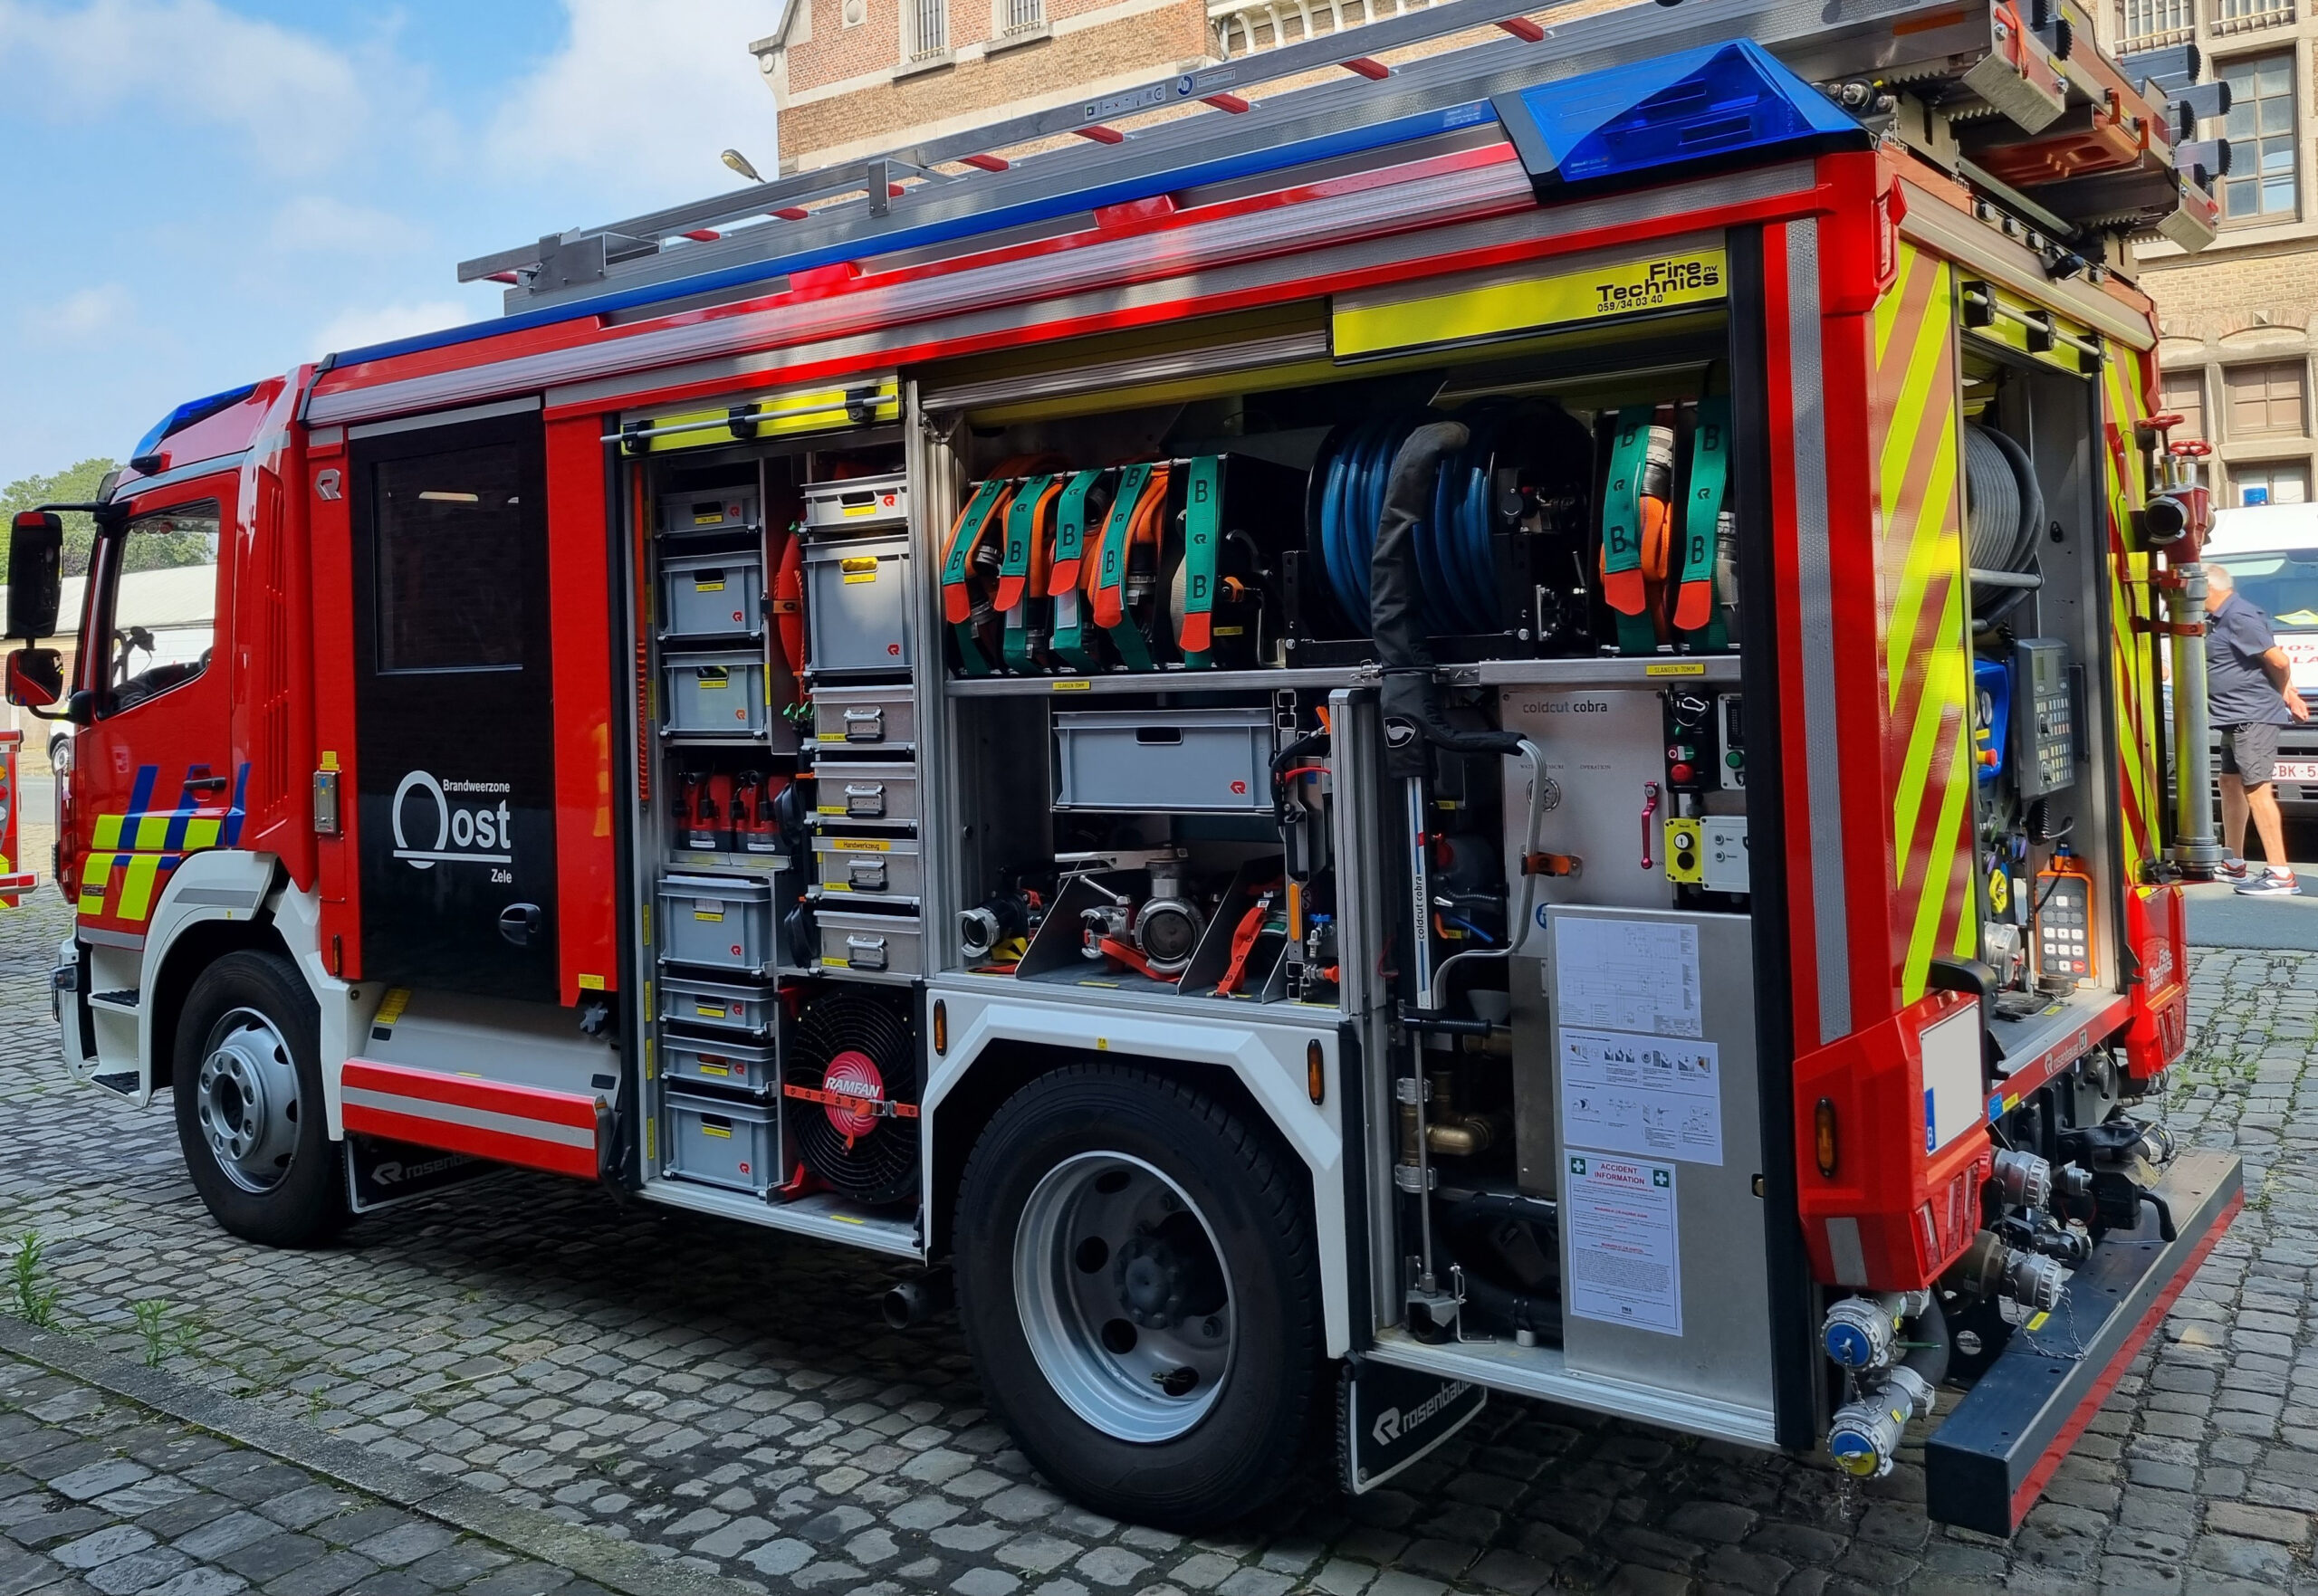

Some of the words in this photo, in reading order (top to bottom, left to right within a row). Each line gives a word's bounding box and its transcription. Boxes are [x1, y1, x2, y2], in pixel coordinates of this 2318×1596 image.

[1650, 261, 1701, 282] Fire
[1596, 272, 1719, 302] Technics
[1597, 299, 1633, 312] 059/34
[1635, 297, 1648, 307] 03
[1651, 294, 1663, 304] 40
[1702, 425, 1719, 452] B
[1126, 467, 1141, 488] B
[1195, 479, 1209, 503] B
[1063, 522, 1076, 547] B
[1610, 525, 1627, 554] B
[952, 550, 963, 571] B
[1011, 540, 1022, 563] B
[1106, 550, 1116, 573] B
[1691, 535, 1705, 565] B
[1193, 574, 1207, 599] B
[1523, 702, 1570, 713] coldcut
[1574, 700, 1607, 712] cobra
[443, 779, 511, 793] Brandweerzone
[392, 770, 512, 869] Oost
[843, 840, 880, 851] Handwerkzeug
[491, 868, 512, 884] Zele
[1413, 875, 1423, 902] cobra
[1416, 903, 1425, 940] coldcut
[825, 1076, 880, 1097] RAMFAN
[1927, 1126, 1934, 1147] B
[406, 1154, 479, 1179] rosenb
[1595, 1171, 1644, 1185] INFORMATION
[1600, 1163, 1638, 1174] ACCIDENT
[1403, 1380, 1472, 1433] rosenbau
